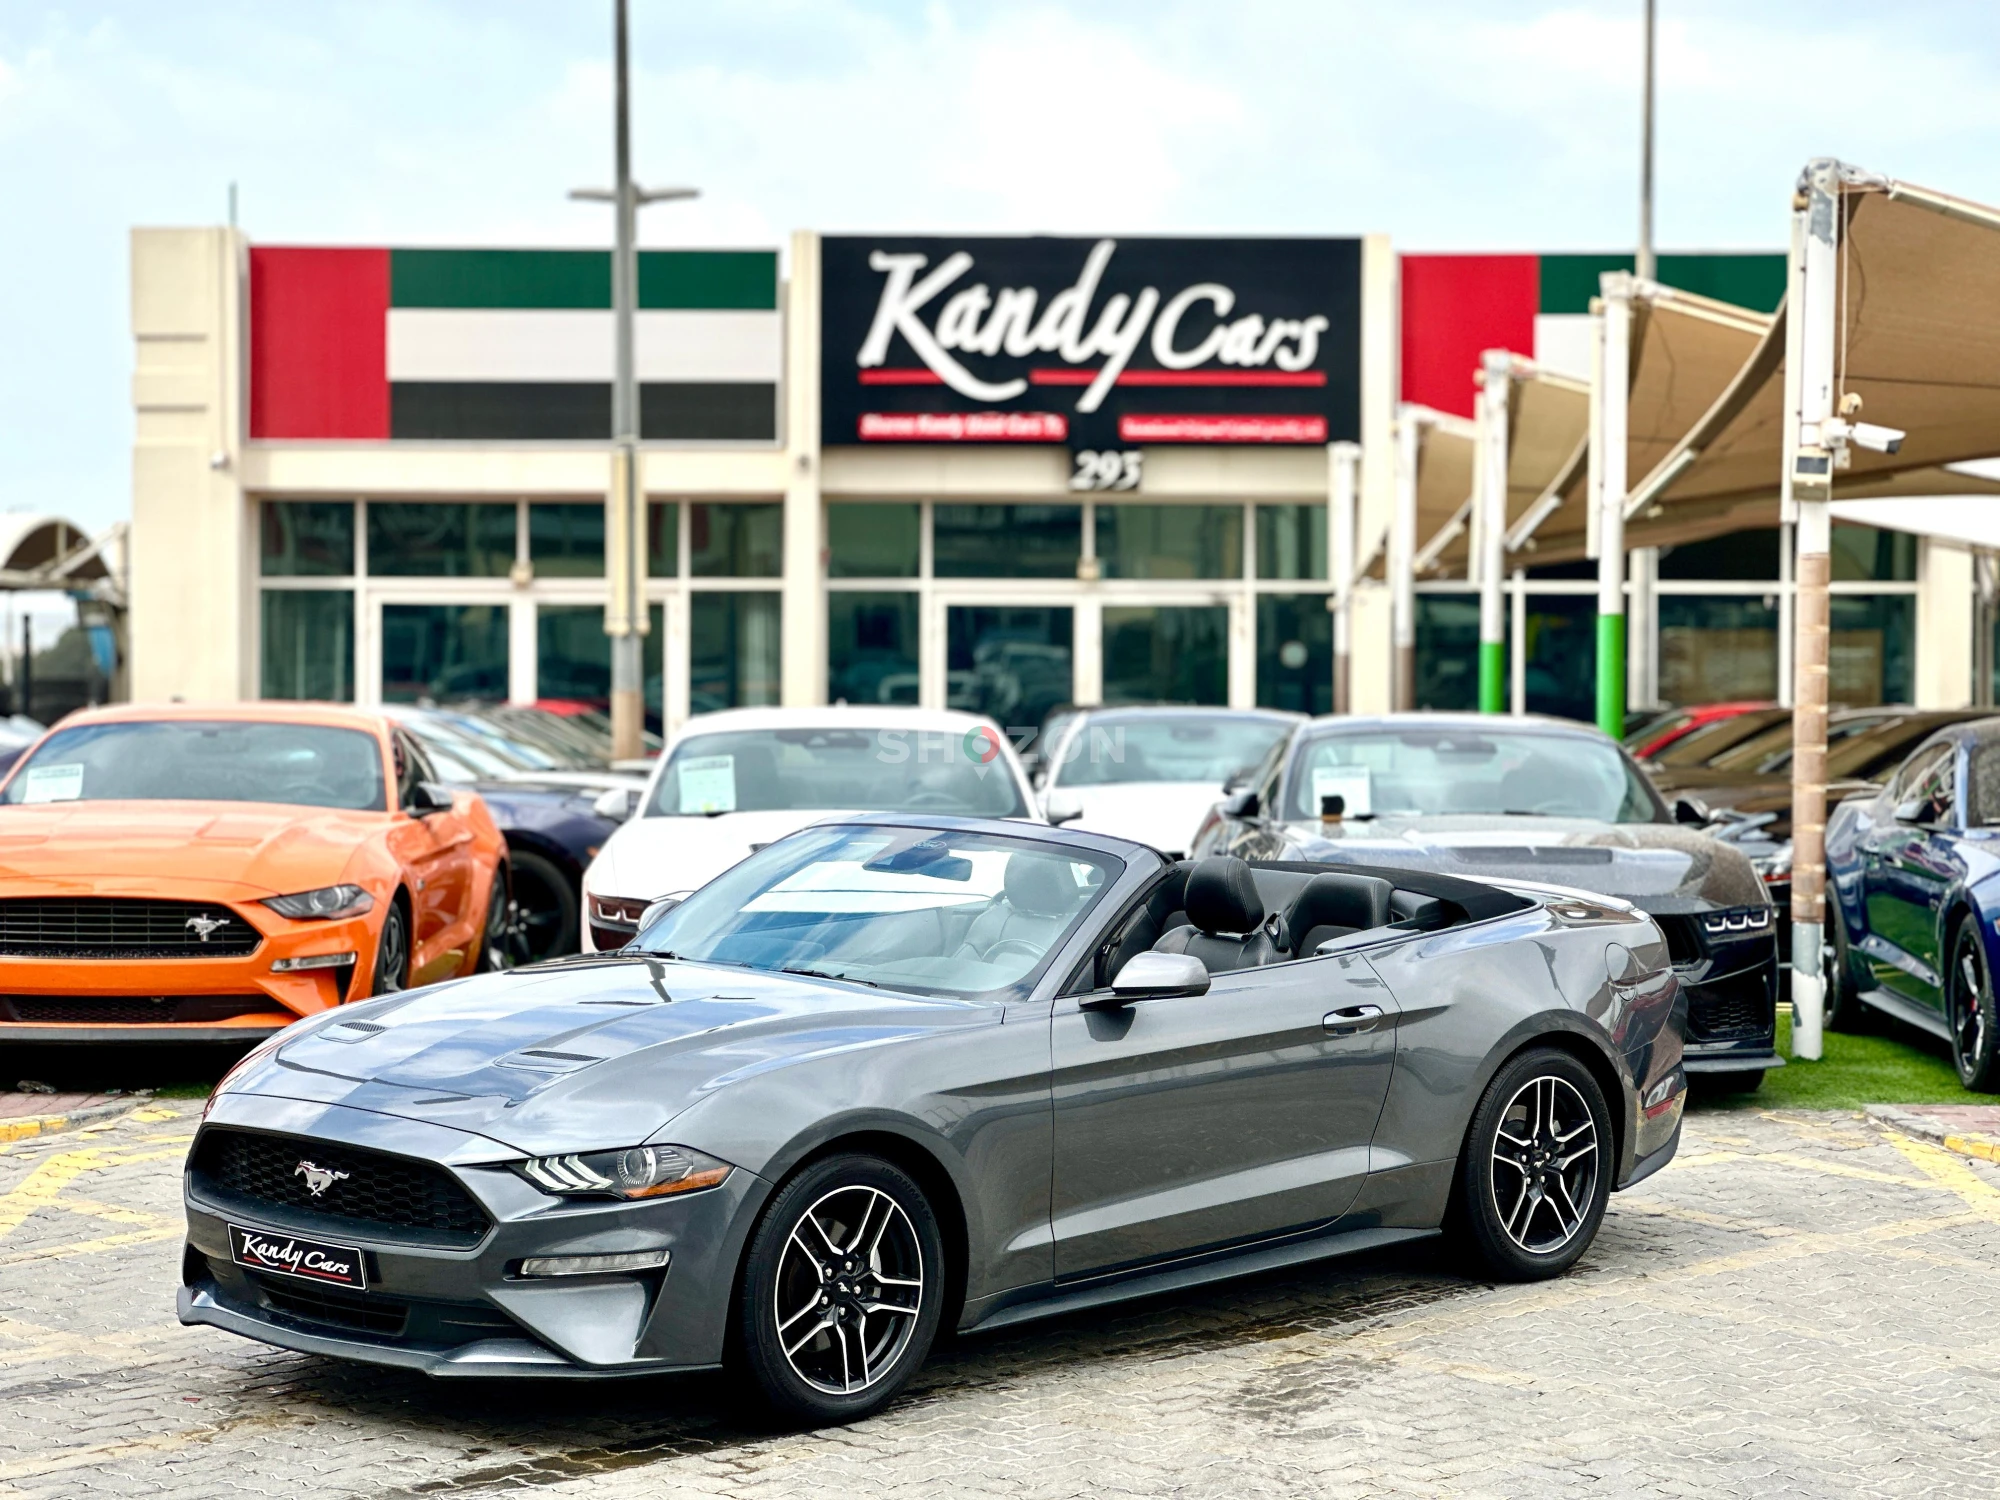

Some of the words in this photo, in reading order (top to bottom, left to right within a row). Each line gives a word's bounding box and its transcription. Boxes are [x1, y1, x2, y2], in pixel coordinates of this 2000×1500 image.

[857, 239, 1160, 413] Kandy
[1151, 283, 1329, 372] Cars
[1070, 449, 1143, 490] 295
[880, 1166, 932, 1221] IRONMAN
[240, 1232, 303, 1272] Kandy
[304, 1251, 350, 1274] Cars
